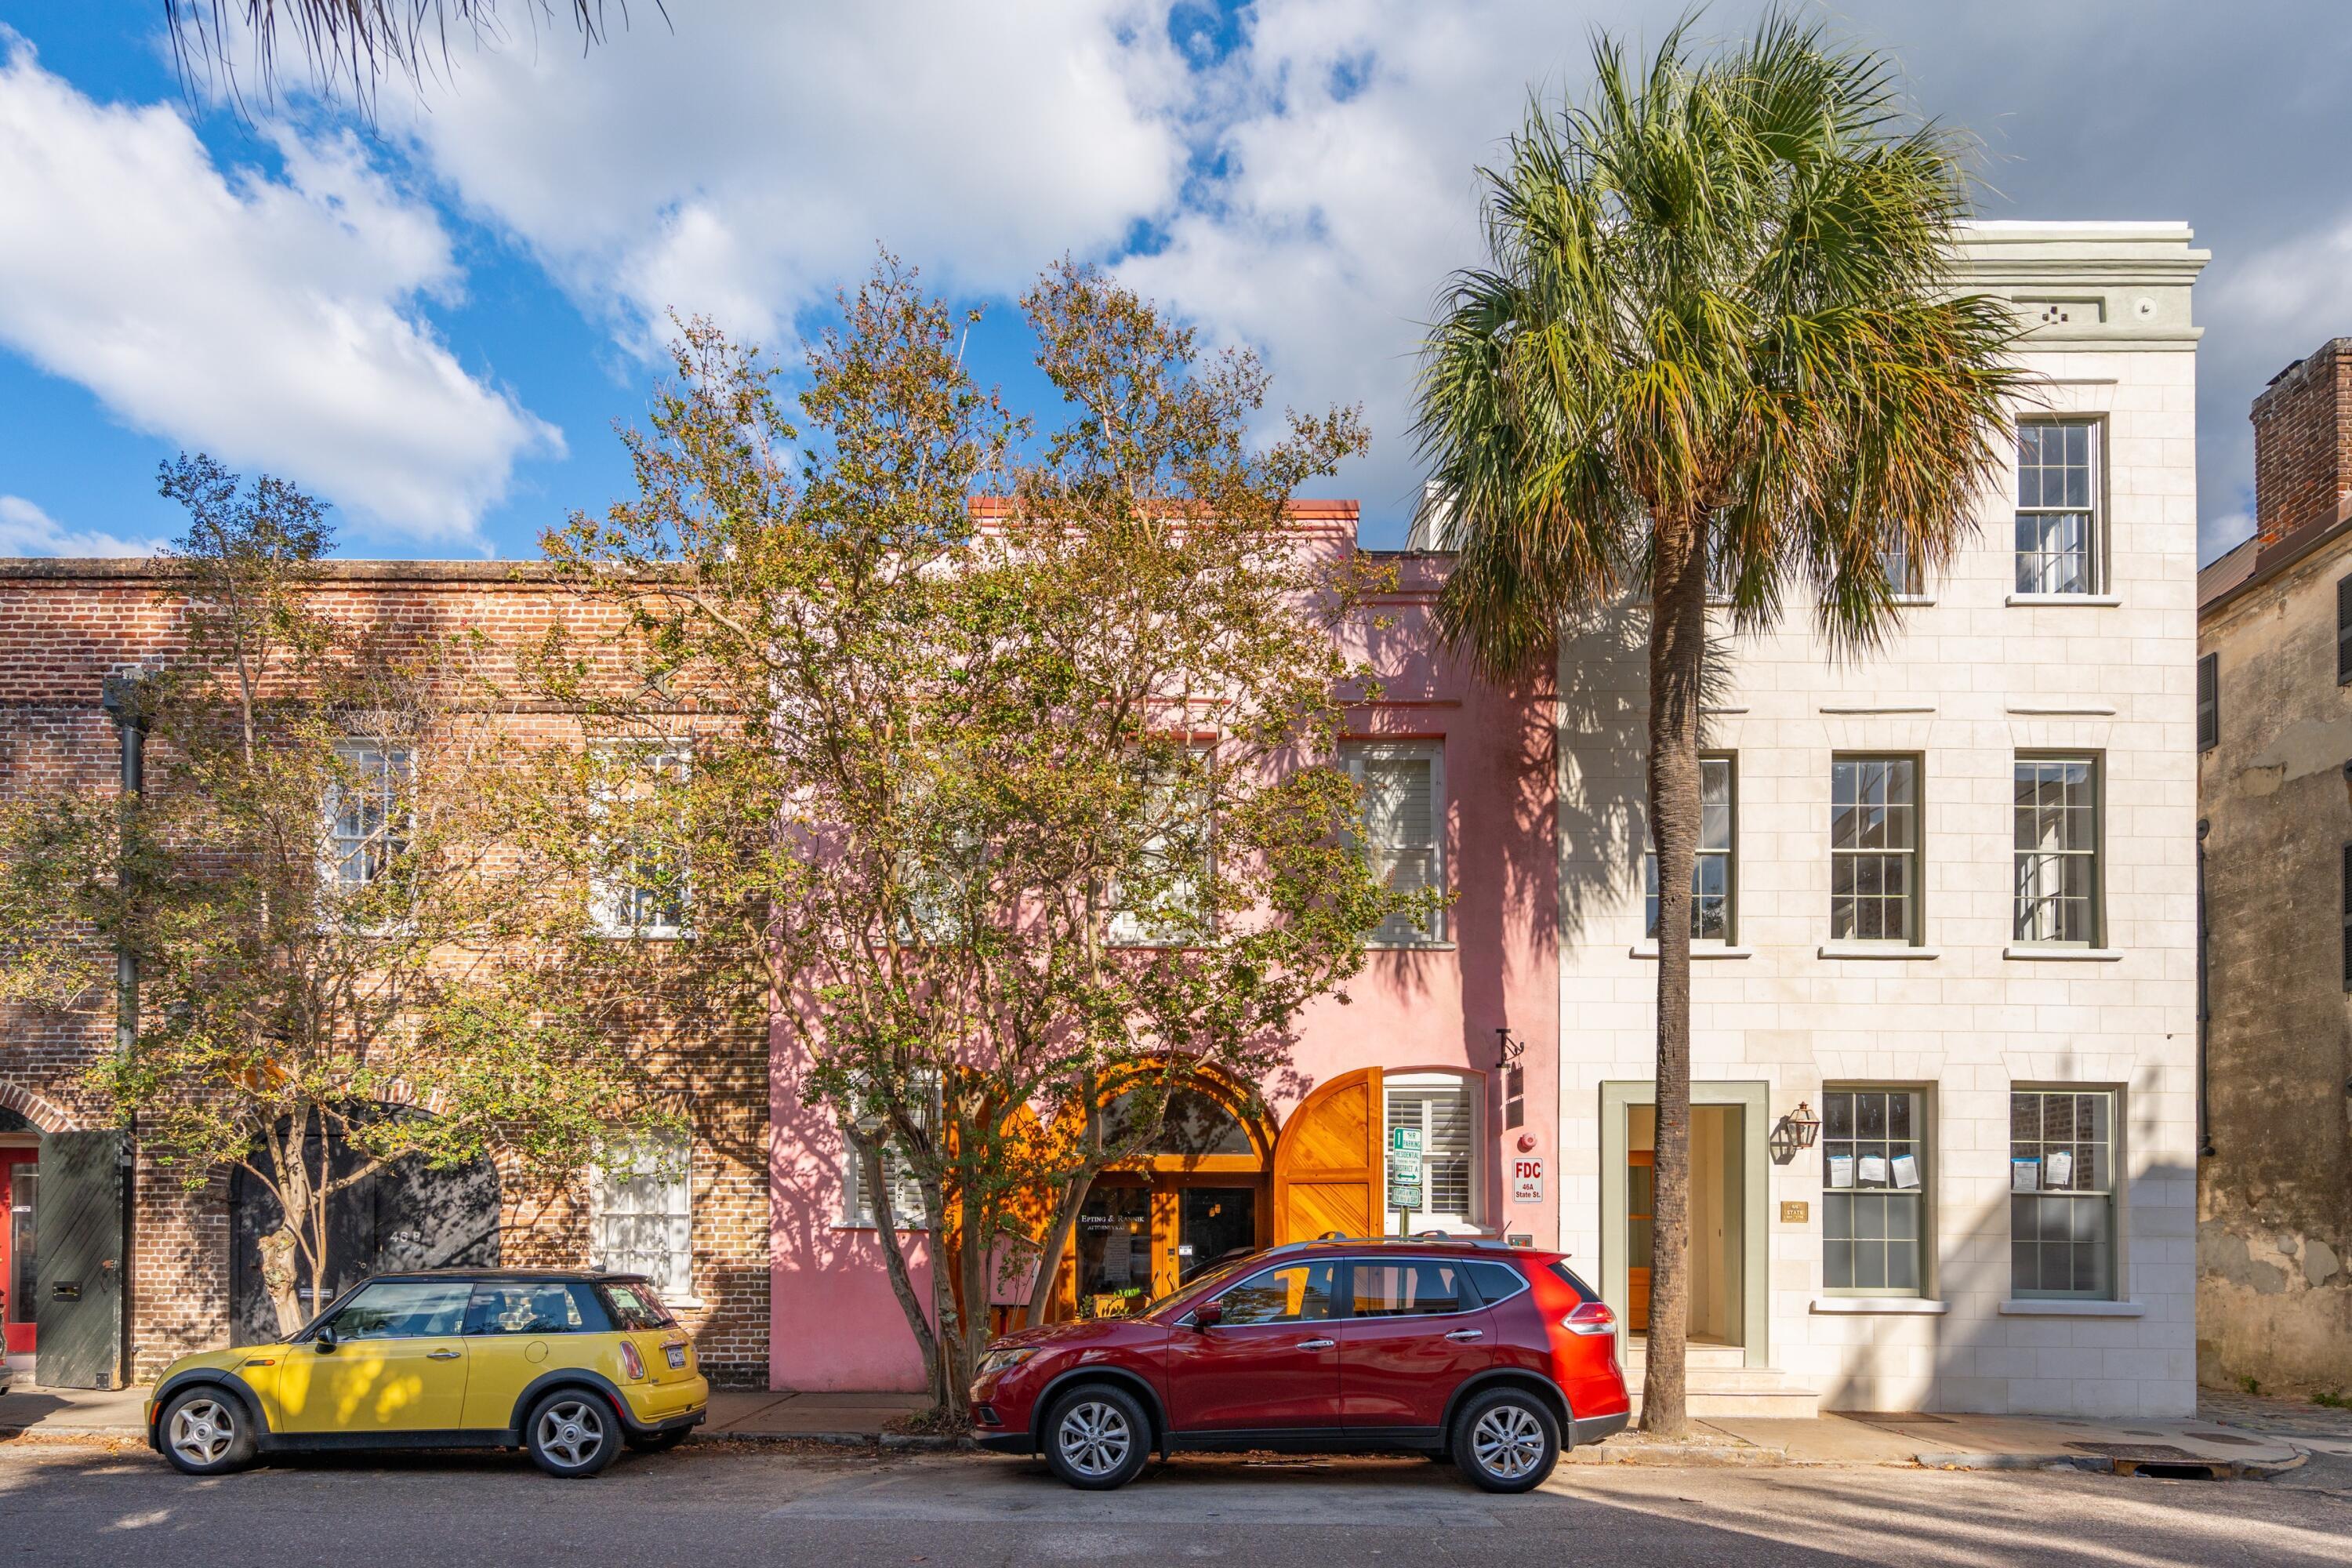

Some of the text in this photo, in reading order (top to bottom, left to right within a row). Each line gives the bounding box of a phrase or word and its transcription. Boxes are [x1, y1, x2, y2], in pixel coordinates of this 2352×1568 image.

[1515, 1162, 1541, 1178] FDC
[390, 1232, 421, 1243] 46 B
